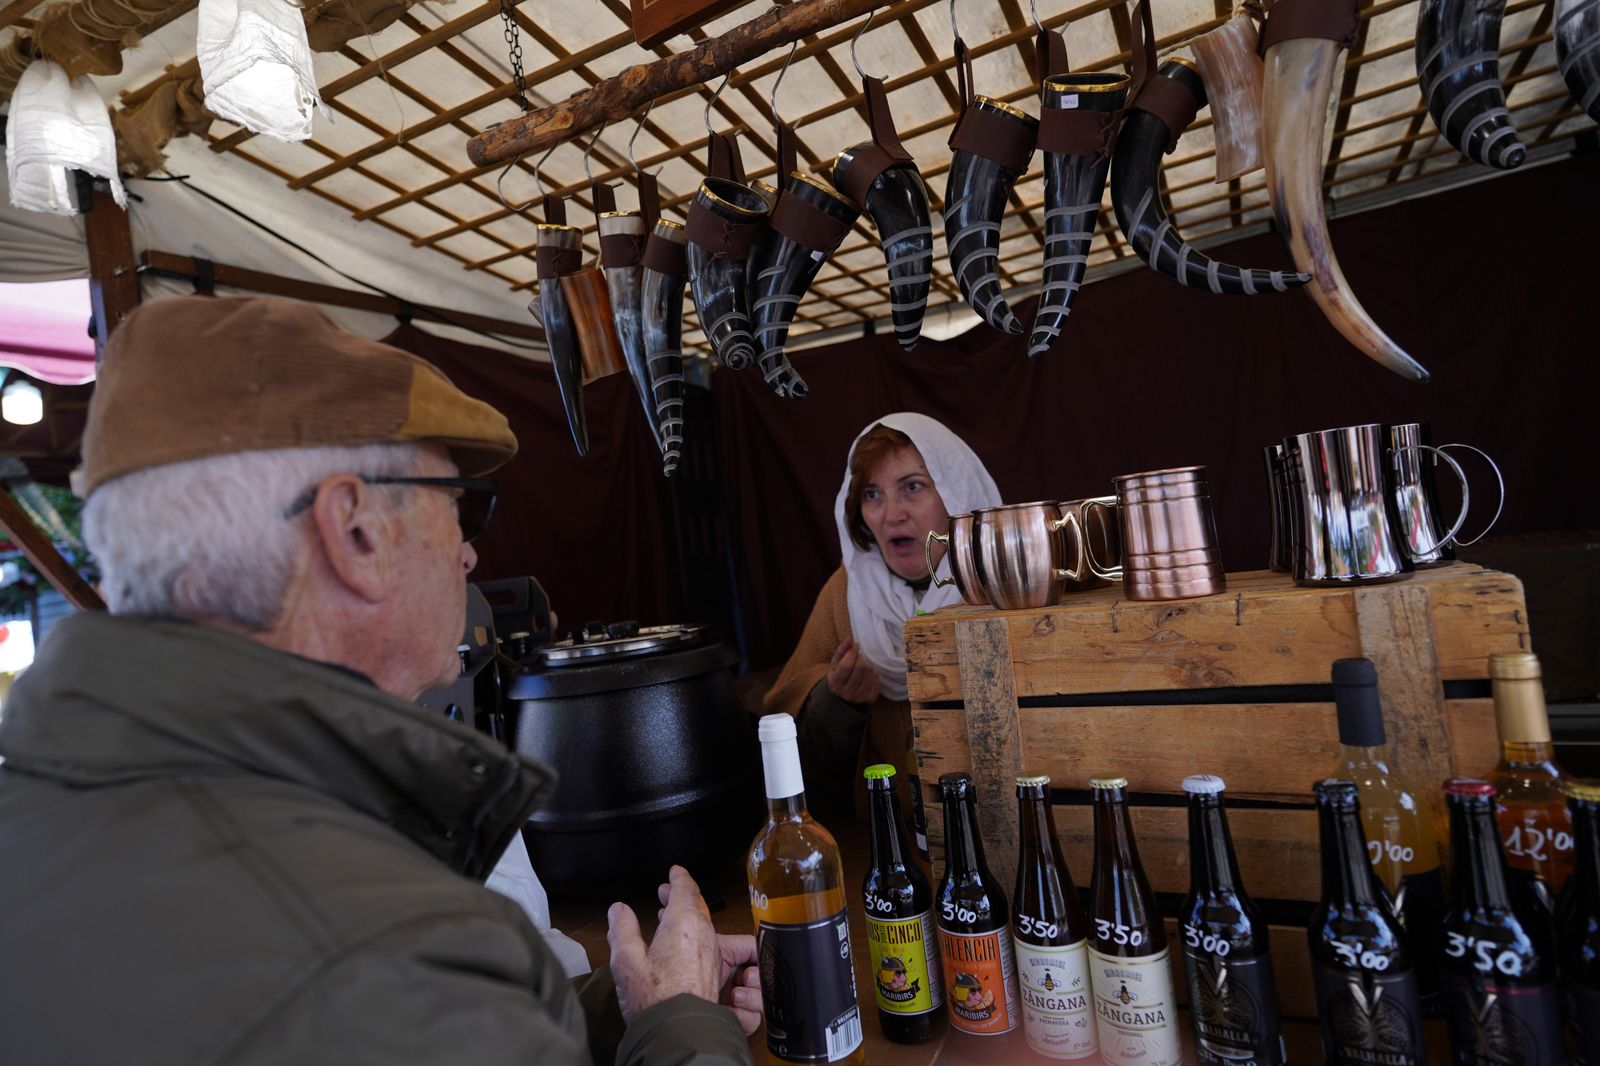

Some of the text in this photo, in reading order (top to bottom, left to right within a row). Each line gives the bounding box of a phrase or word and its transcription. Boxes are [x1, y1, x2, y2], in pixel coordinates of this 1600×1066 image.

[865, 892, 893, 912] 3'00
[942, 900, 977, 923] 3'00
[887, 922, 921, 944] CINCO
[1019, 913, 1058, 938] 3'50
[1095, 917, 1143, 946] 3'50
[942, 936, 996, 961] ALENCIA
[1184, 923, 1231, 957] 3'00
[1444, 930, 1522, 977] 3'50
